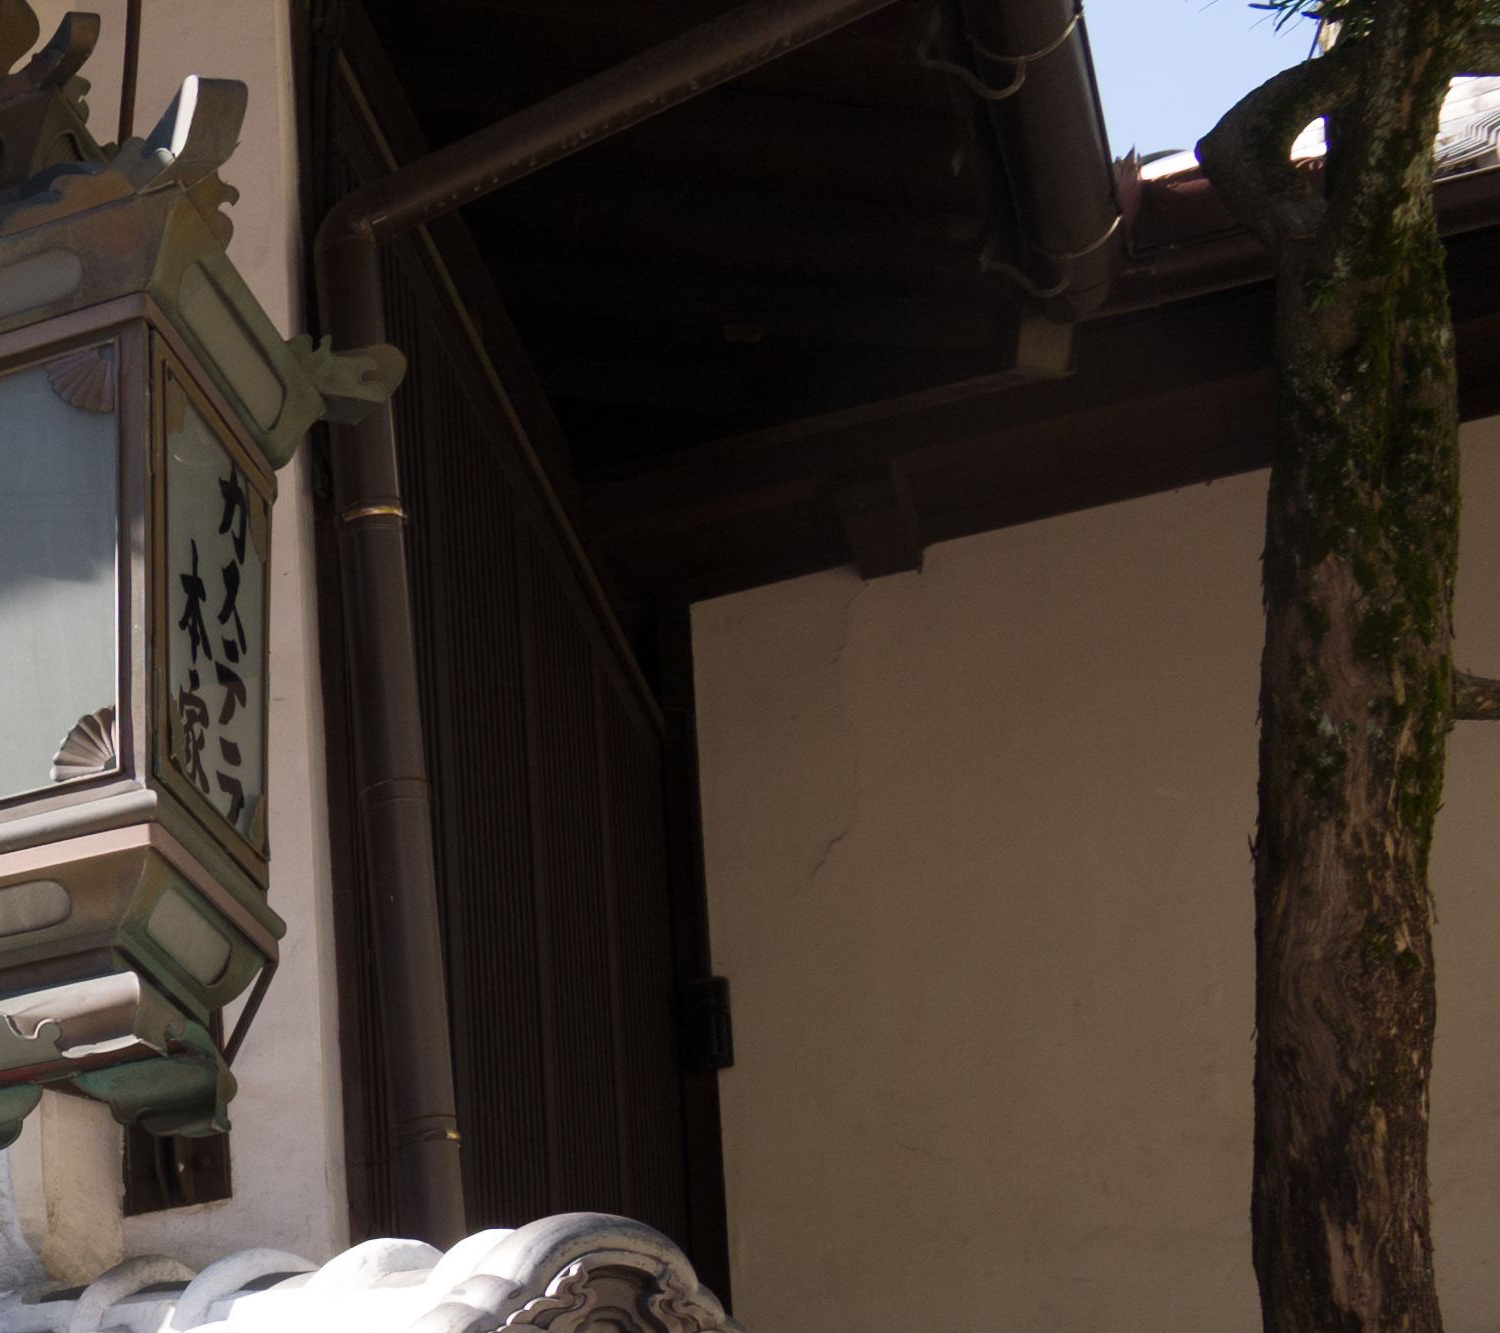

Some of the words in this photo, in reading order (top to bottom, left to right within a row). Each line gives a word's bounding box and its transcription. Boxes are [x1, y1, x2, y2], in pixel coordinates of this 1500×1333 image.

[178, 538, 212, 795] 本家
[214, 460, 248, 827] カステラ
